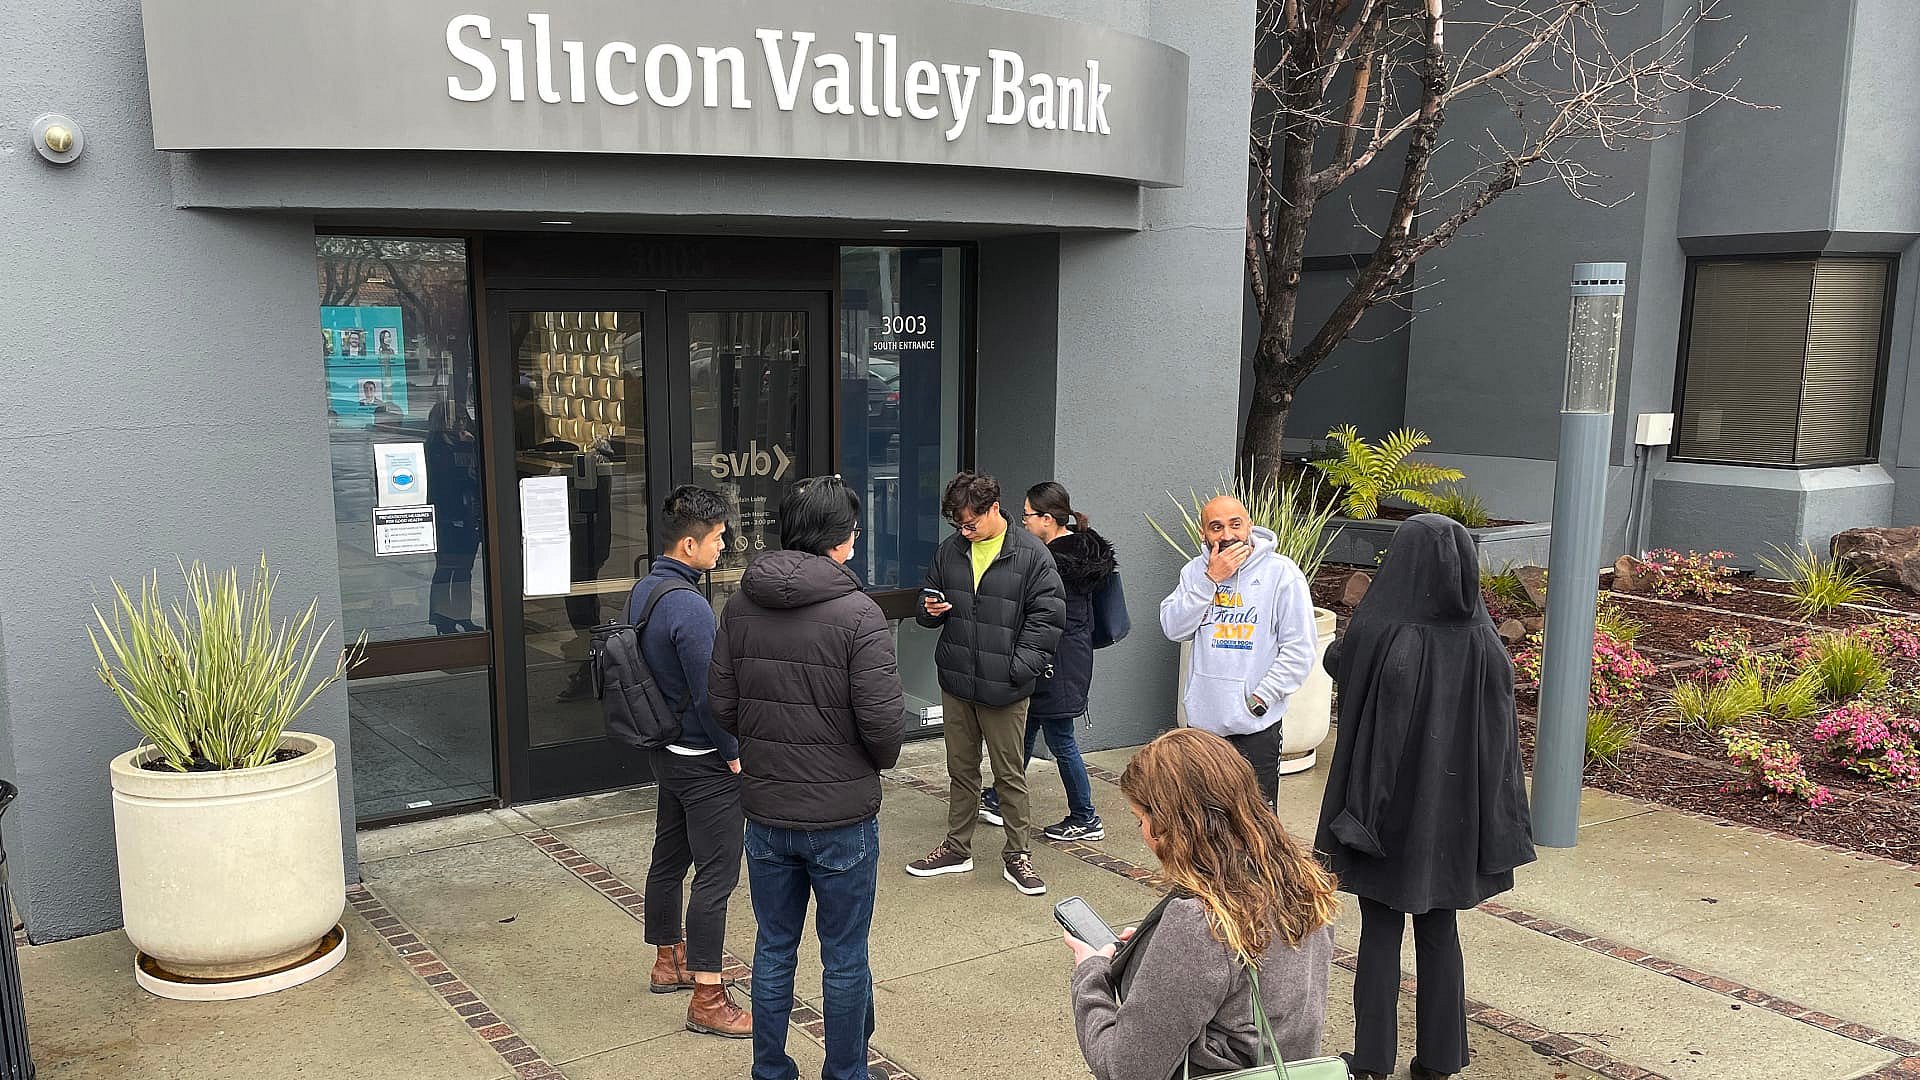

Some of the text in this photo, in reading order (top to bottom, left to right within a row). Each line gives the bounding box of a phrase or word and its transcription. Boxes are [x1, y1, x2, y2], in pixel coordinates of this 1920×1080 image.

[446, 13, 1112, 142] Silicon Valley Bank
[881, 315, 927, 335] 3003
[873, 340, 935, 350] SOUTH ENTRANCE
[711, 440, 771, 478] svb
[1213, 623, 1255, 640] 2017
